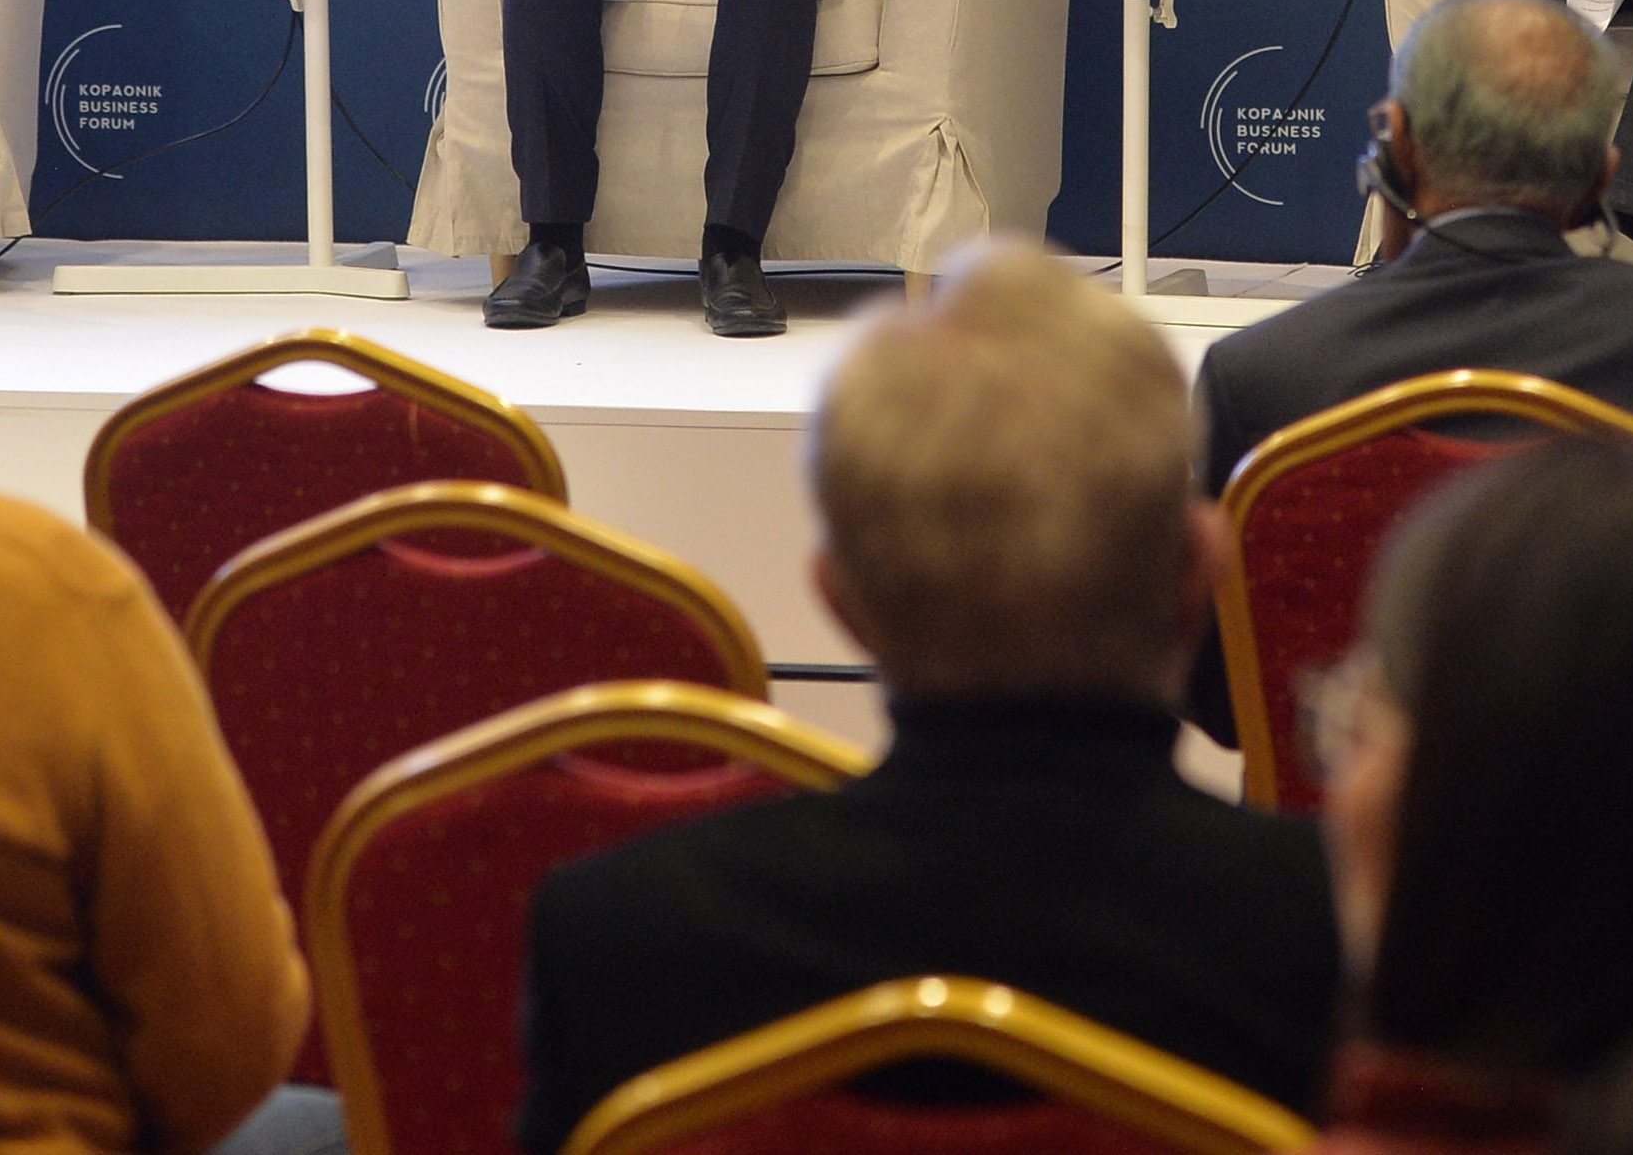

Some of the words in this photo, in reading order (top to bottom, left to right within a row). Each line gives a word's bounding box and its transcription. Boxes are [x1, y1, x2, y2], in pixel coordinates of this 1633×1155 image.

[80, 85, 162, 97] KOPAONIK
[80, 101, 157, 113] BUSINESS
[80, 118, 134, 129] FORUM
[1237, 142, 1296, 155] FORUM
